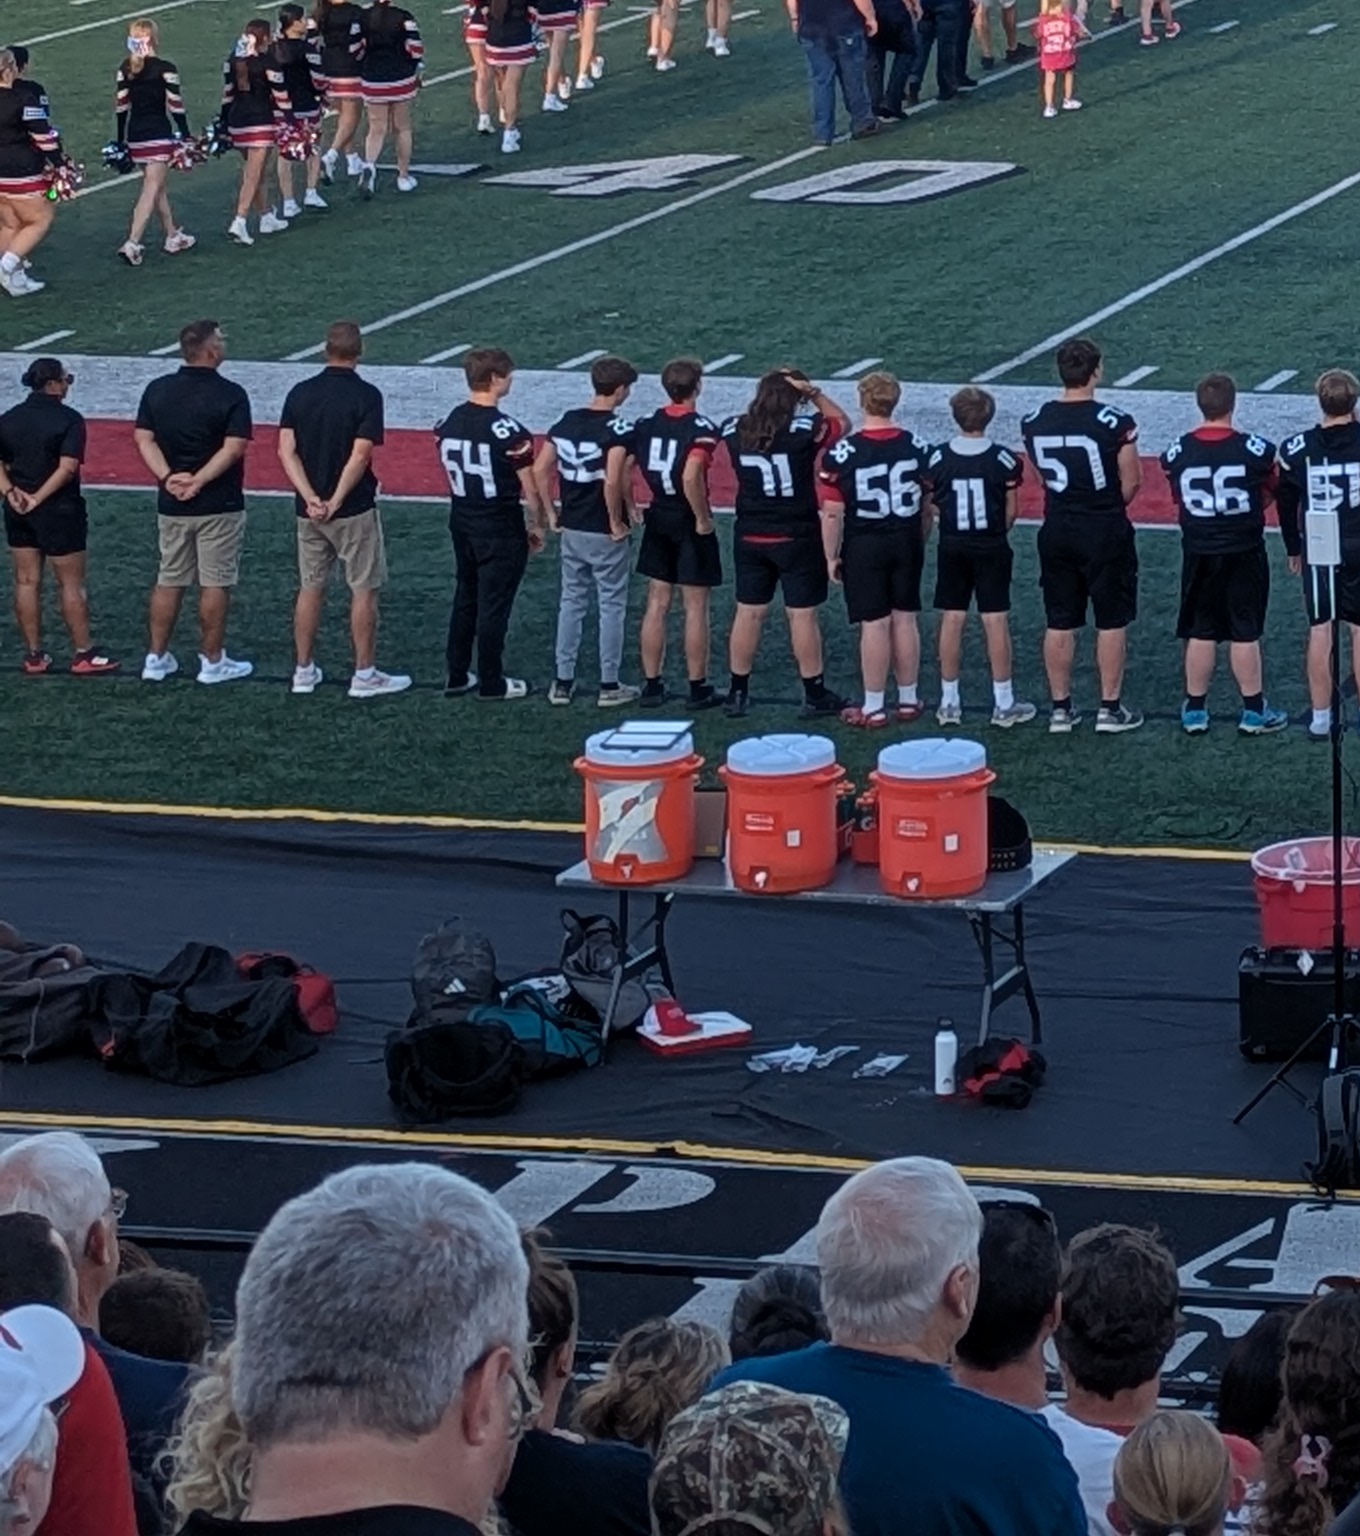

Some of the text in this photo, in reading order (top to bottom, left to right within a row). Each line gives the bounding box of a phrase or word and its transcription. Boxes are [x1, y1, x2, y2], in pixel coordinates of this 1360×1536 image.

[492, 418, 521, 440] 64
[441, 438, 498, 500] 64
[649, 437, 677, 496] 4
[739, 454, 794, 498] 71
[855, 459, 922, 520] 56
[1033, 435, 1107, 493] 57
[1180, 465, 1252, 517] 66
[952, 478, 988, 531] 11
